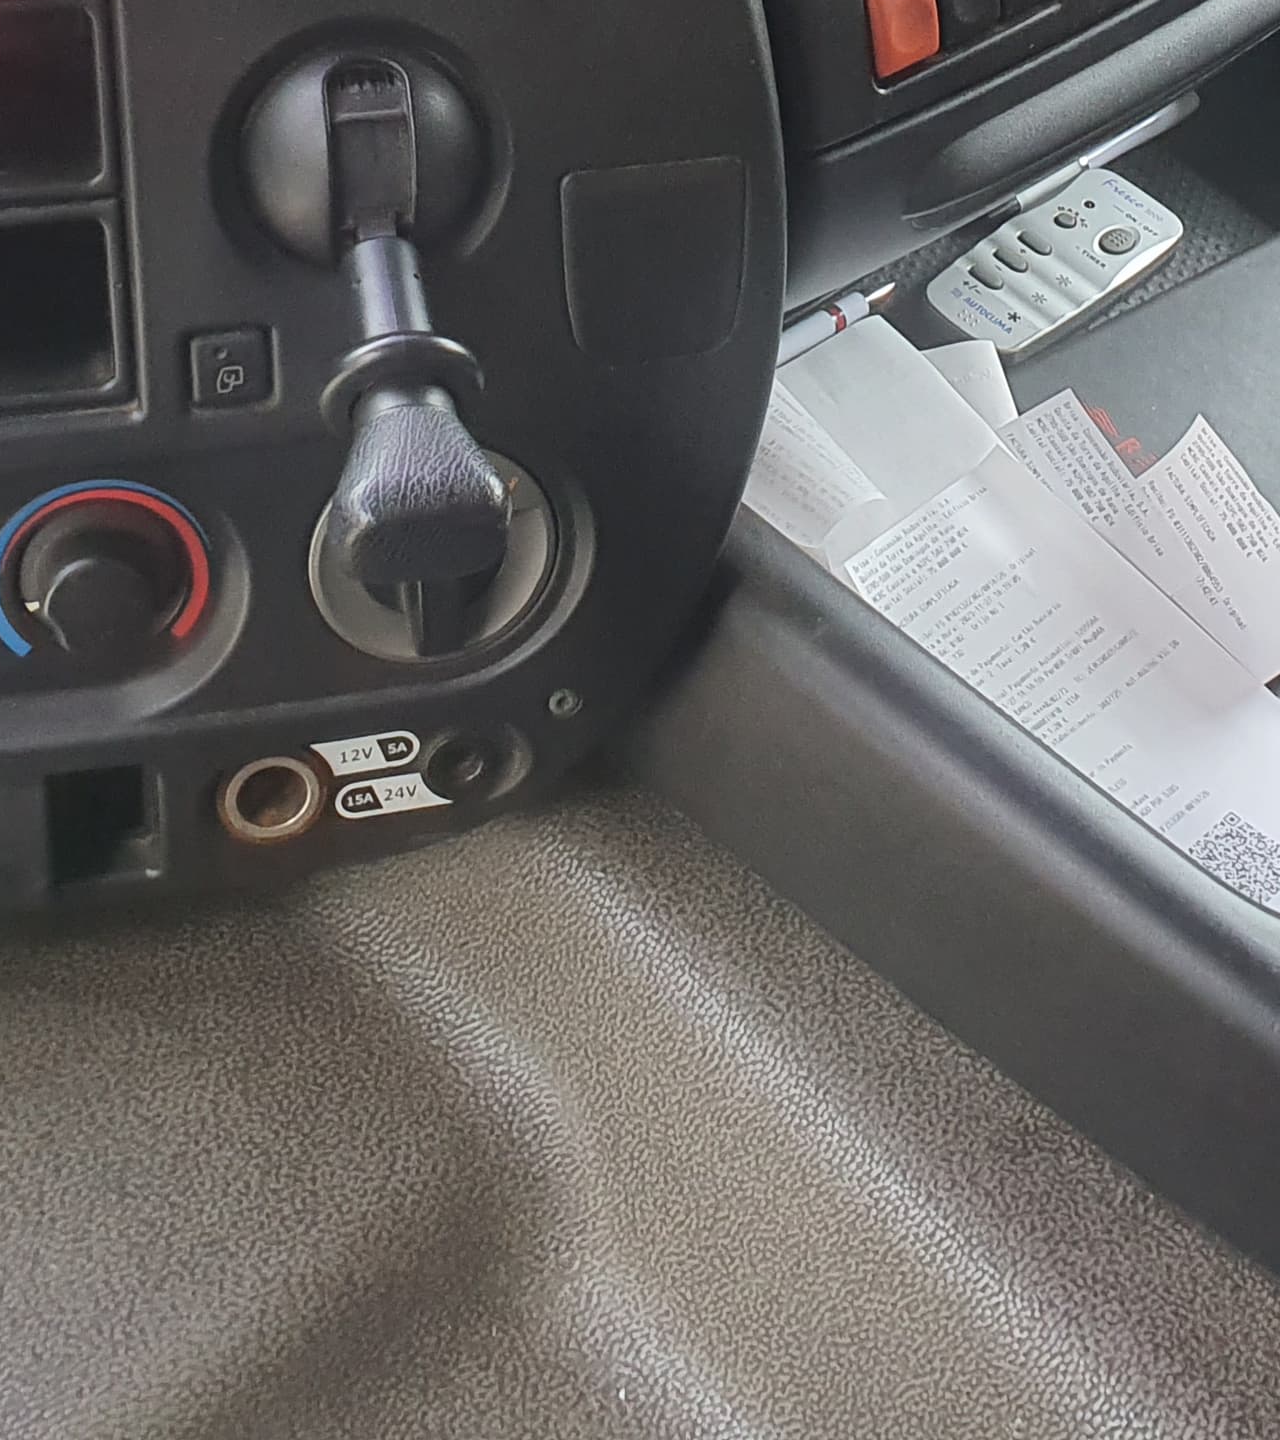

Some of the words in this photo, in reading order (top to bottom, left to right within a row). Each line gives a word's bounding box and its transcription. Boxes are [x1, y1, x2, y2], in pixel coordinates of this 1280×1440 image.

[963, 295, 1013, 335] AUTOCLIMA
[339, 746, 373, 764] 12V
[387, 741, 408, 756] 5A
[346, 792, 375, 808] 15A
[383, 784, 418, 802] 24V
